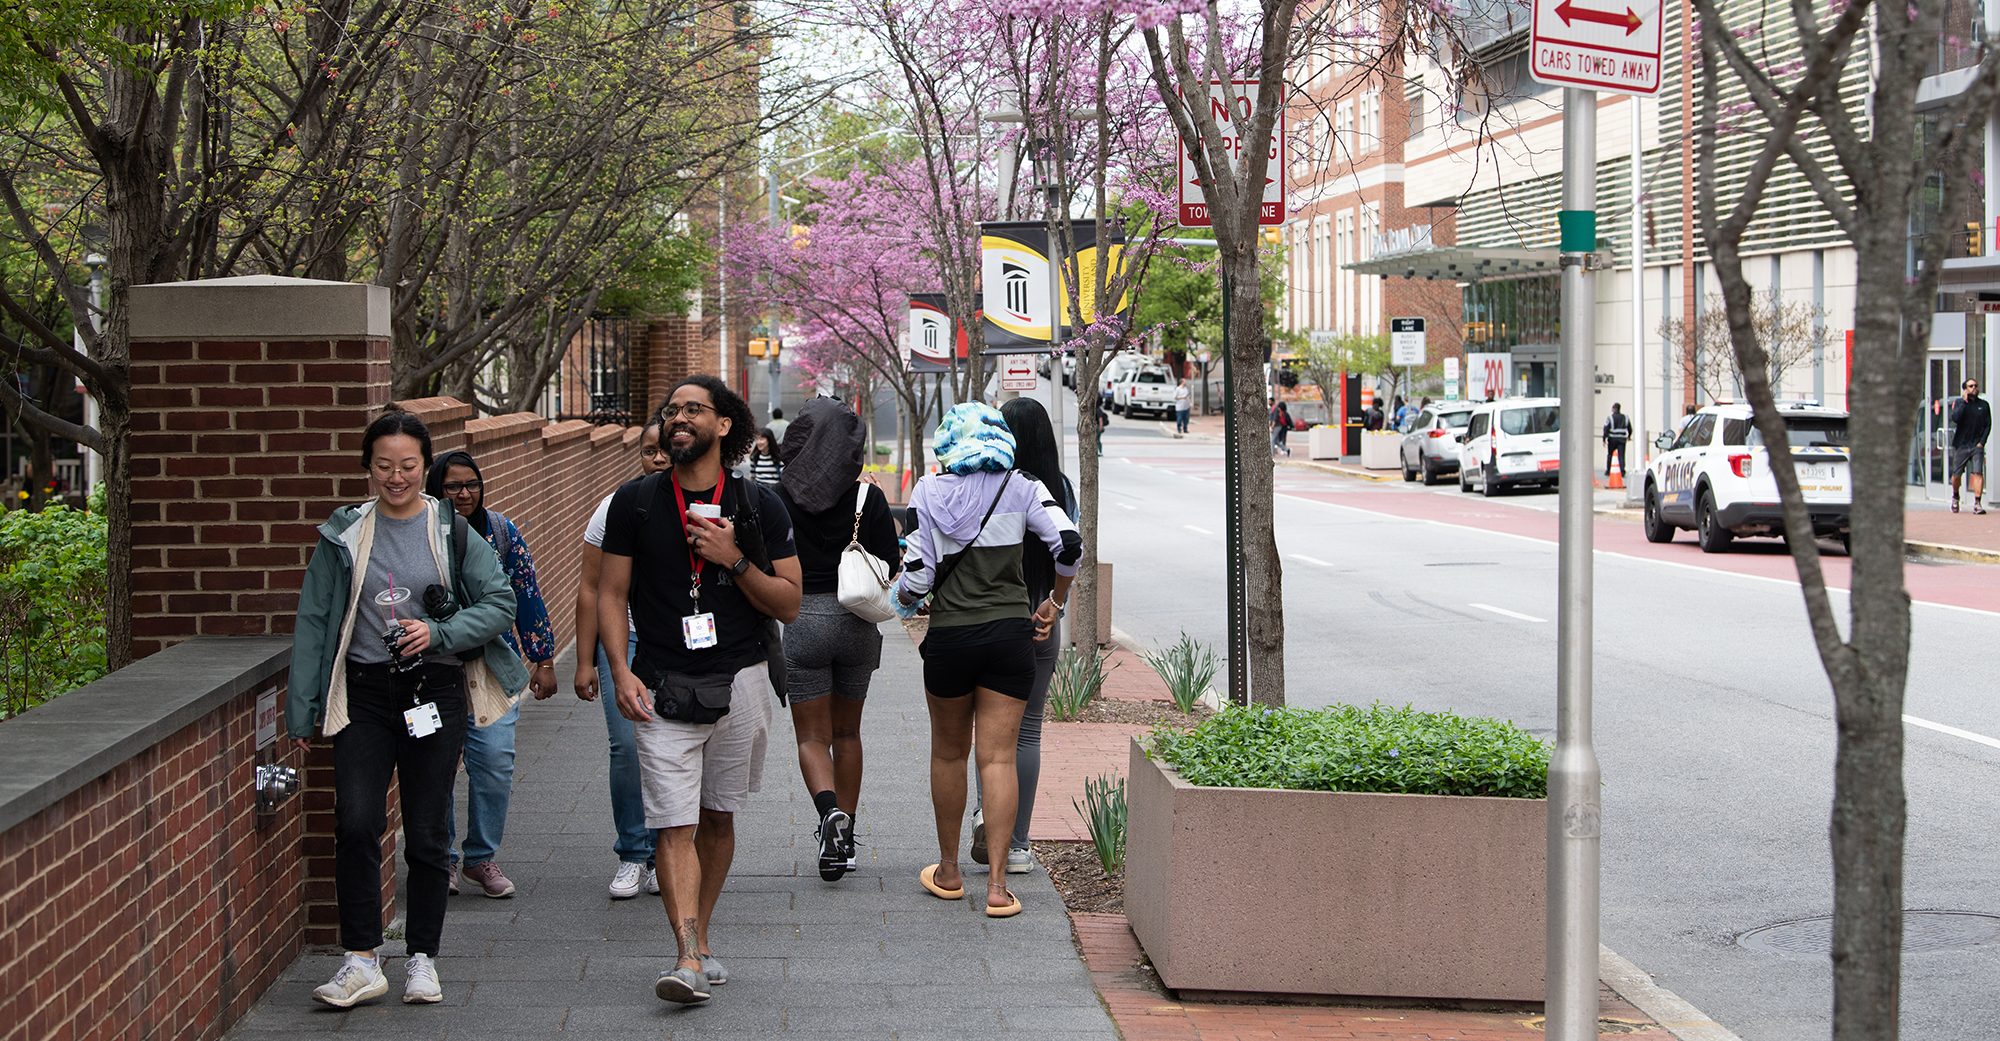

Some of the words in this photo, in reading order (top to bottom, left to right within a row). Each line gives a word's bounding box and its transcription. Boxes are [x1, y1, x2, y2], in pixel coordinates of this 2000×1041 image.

[1541, 48, 1571, 70] CARS
[1578, 54, 1616, 77] TOWED
[1621, 61, 1652, 82] AWAY
[1211, 96, 1252, 122] NO
[1083, 265, 1091, 316] UNIVERSITY
[1485, 359, 1504, 399] 200
[1665, 460, 1697, 492] POLICE
